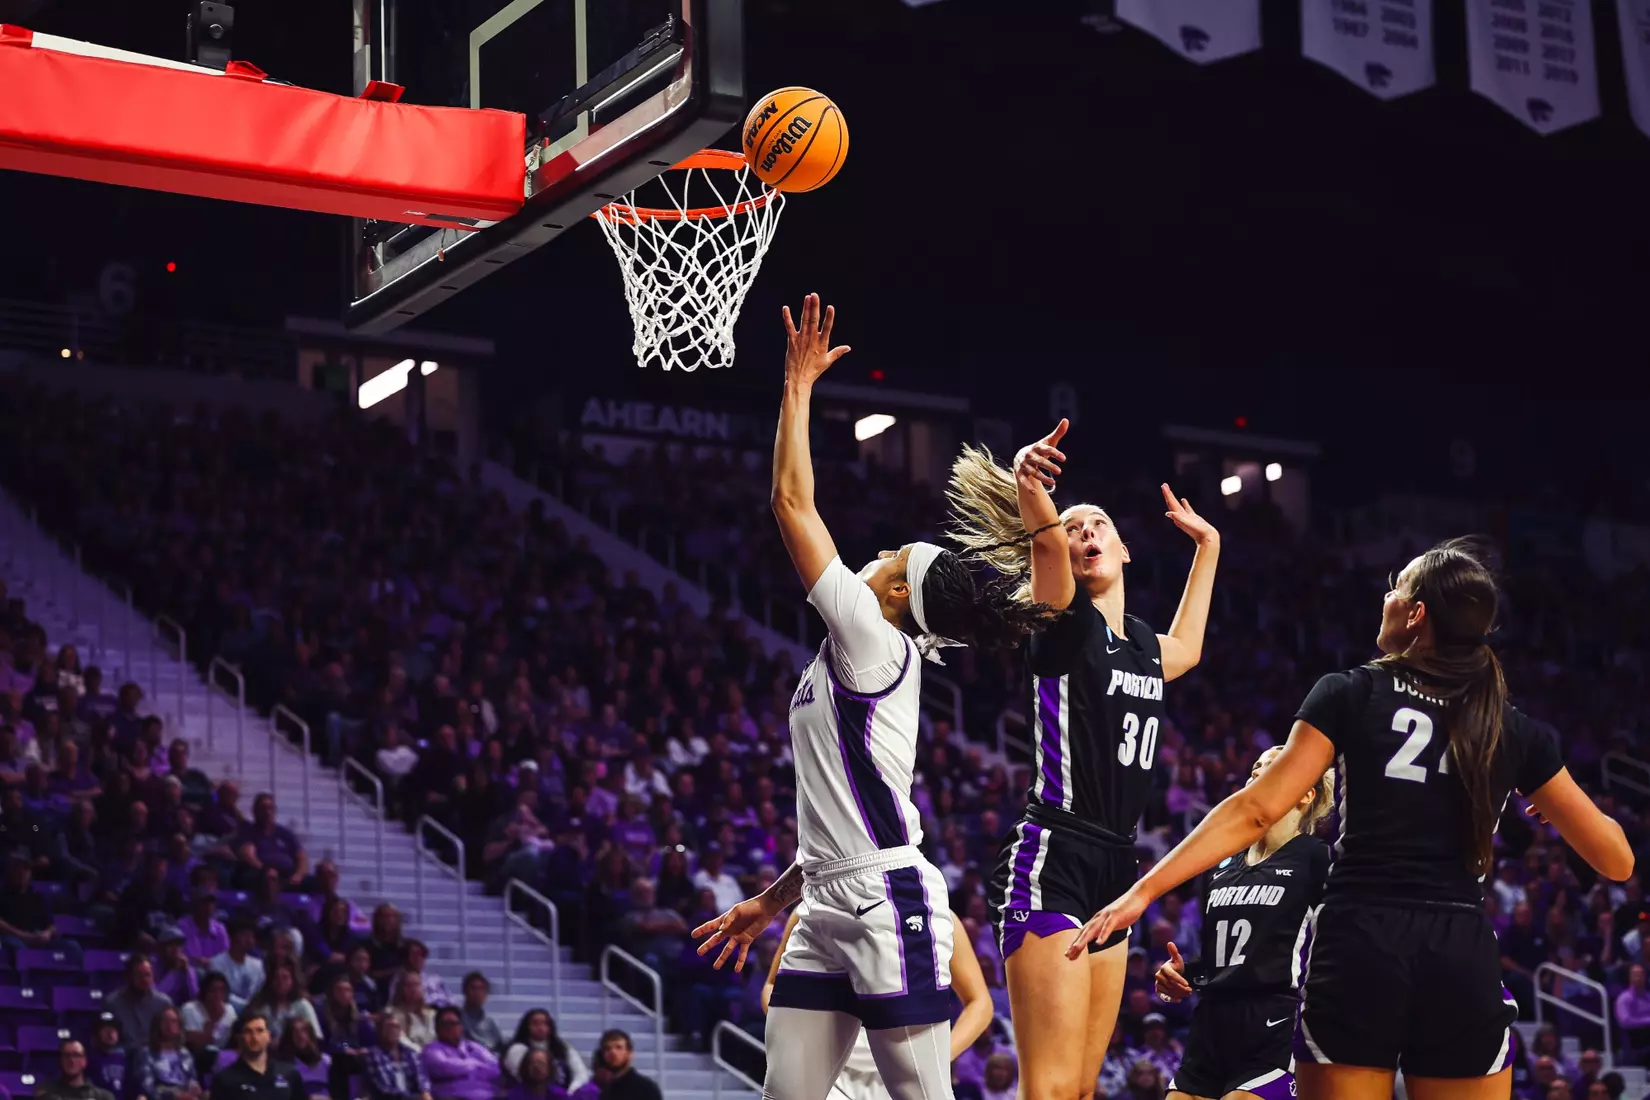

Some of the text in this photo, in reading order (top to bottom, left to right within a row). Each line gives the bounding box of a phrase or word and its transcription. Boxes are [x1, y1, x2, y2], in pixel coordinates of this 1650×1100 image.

[760, 115, 813, 172] Wilson
[580, 397, 730, 440] AHEARN
[1106, 668, 1163, 701] PORTLAN
[1117, 712, 1159, 770] 30
[1384, 707, 1449, 783] 2
[1206, 885, 1285, 914] PORTLAND
[1215, 918, 1252, 968] 12
